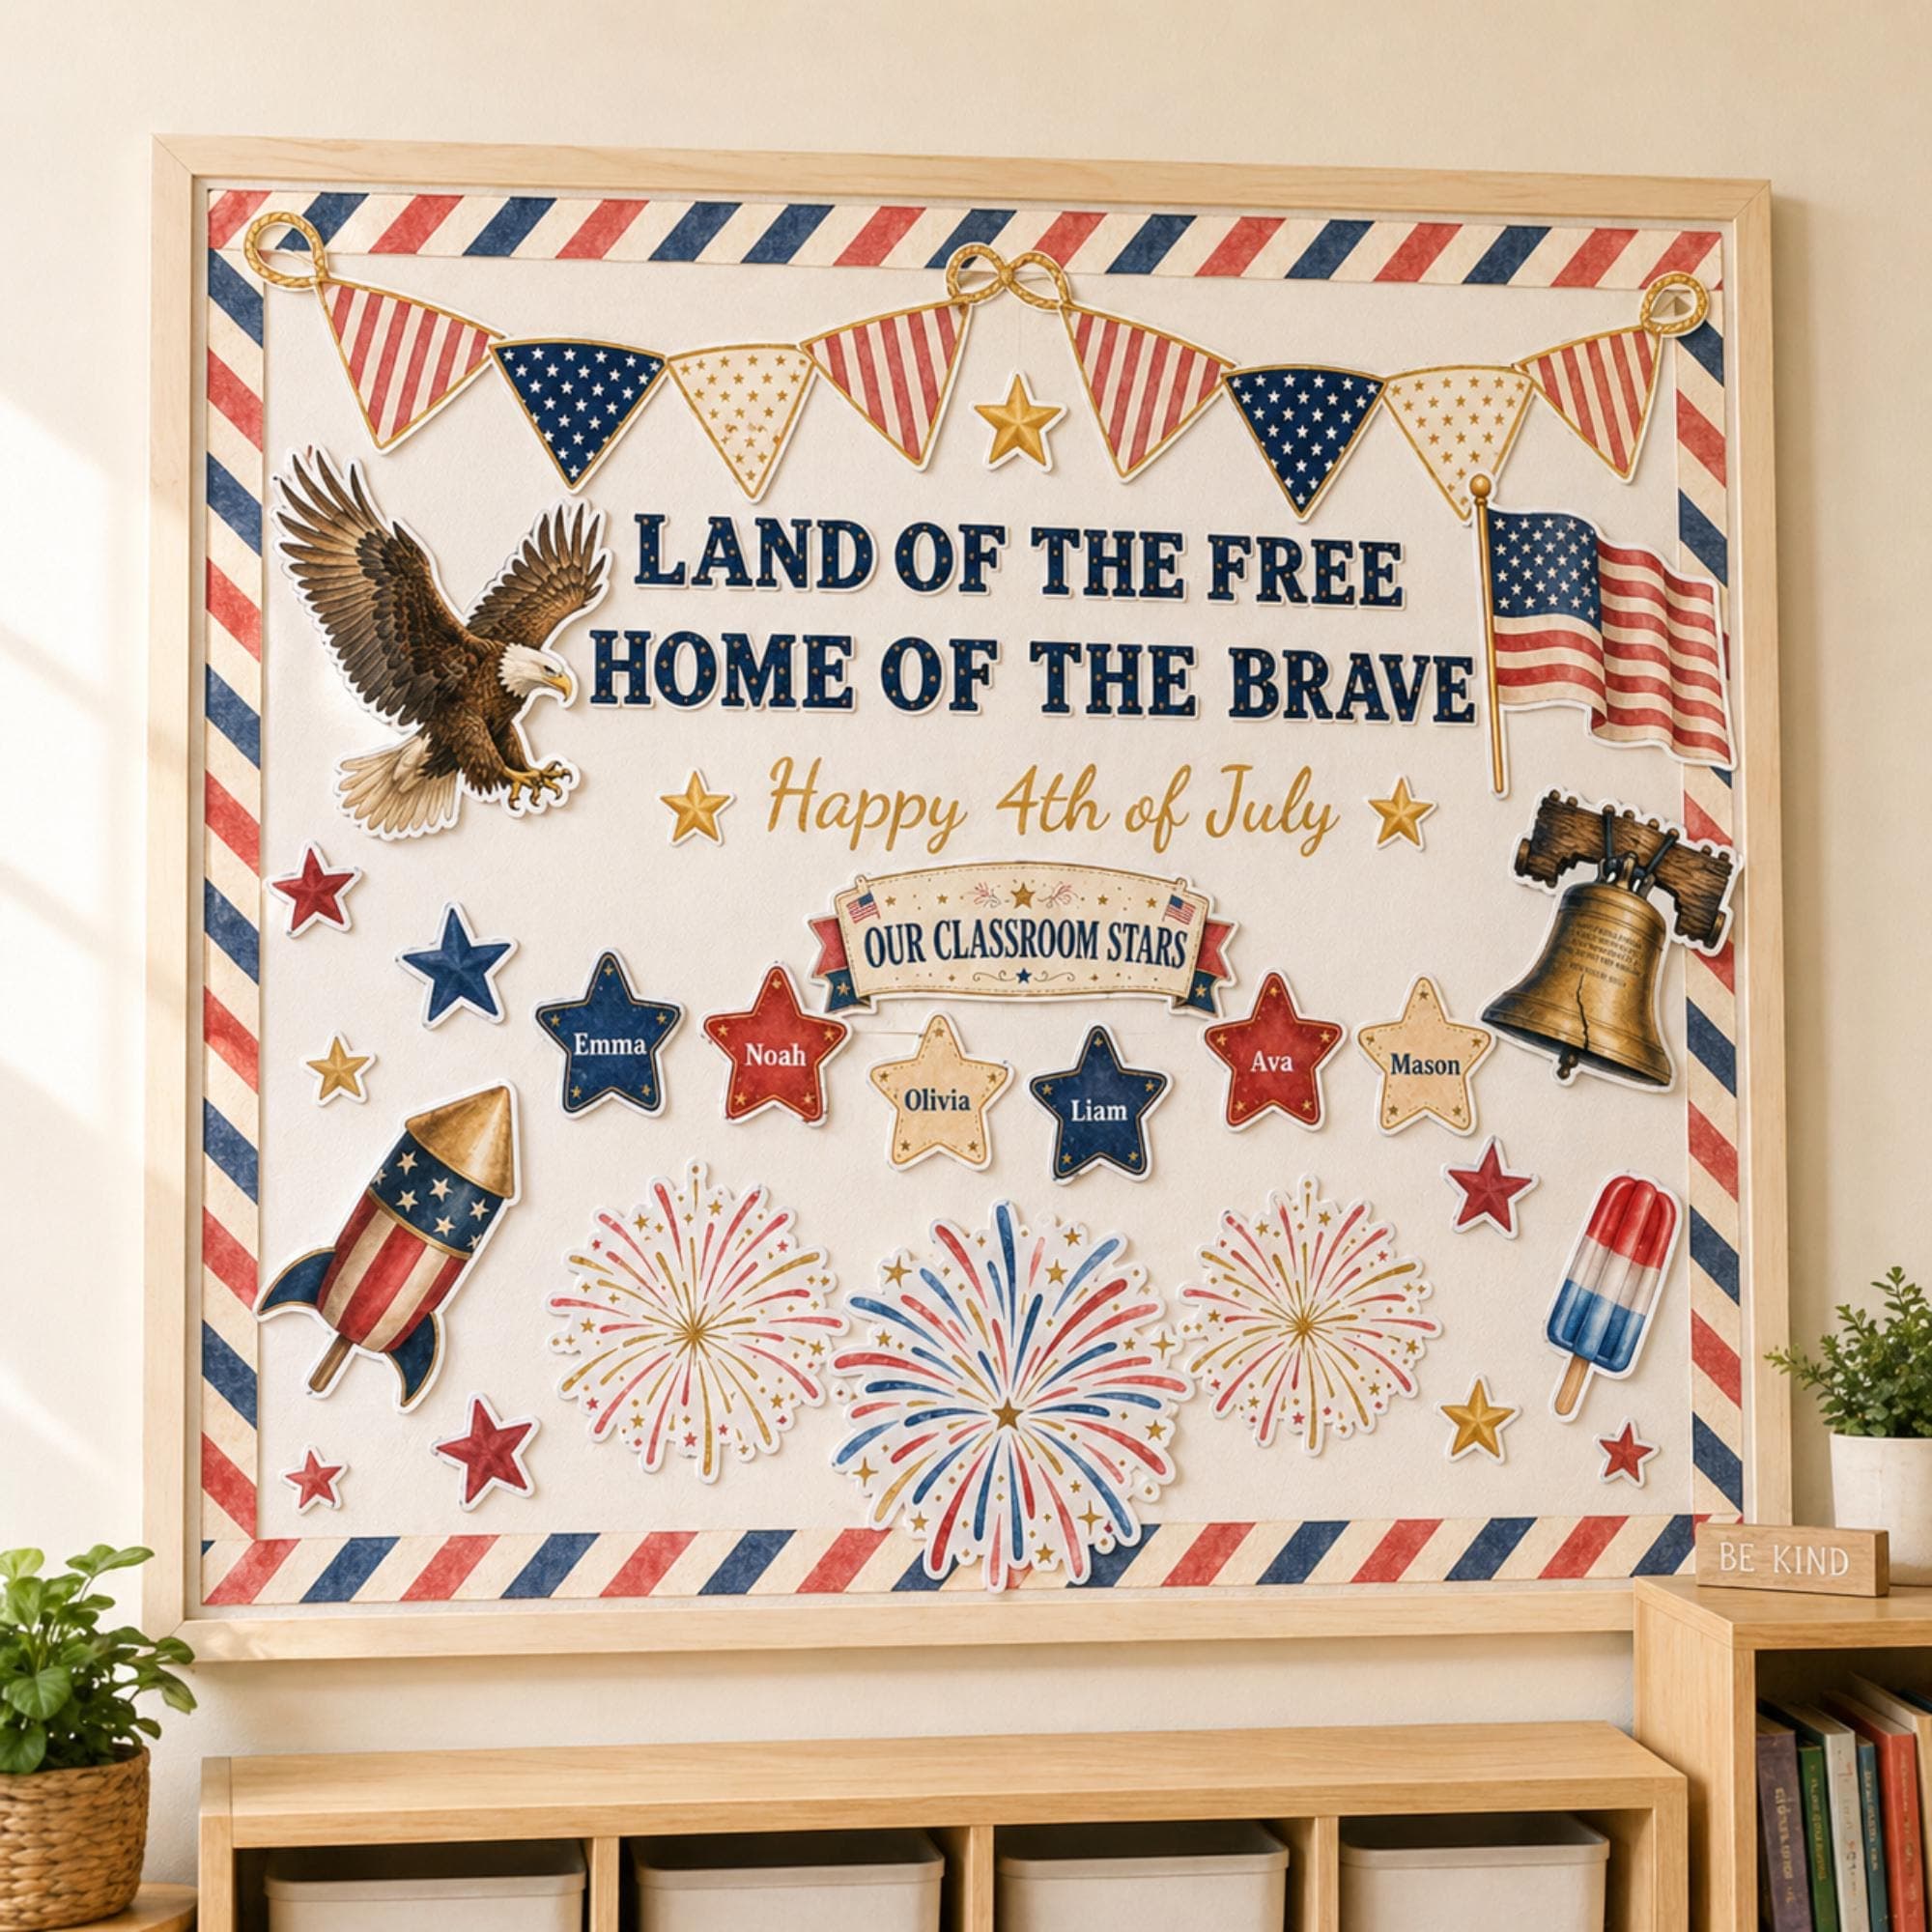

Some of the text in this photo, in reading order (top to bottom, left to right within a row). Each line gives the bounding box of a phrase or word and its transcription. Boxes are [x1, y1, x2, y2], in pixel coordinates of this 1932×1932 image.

[634, 513, 1403, 608] LAND OF THE FREE
[589, 630, 1475, 724] HOME OF THE BRAVE
[767, 755, 1340, 859] Happy 4th of July
[865, 918, 1188, 969] OUR CLASSROOM STARS
[575, 1033, 646, 1055] Emma
[747, 1043, 806, 1066] Noah
[1251, 1050, 1293, 1072] Ava
[1391, 1053, 1461, 1076] Mason
[904, 1088, 971, 1111] Olivia
[1071, 1099, 1127, 1122] Liam
[1719, 1542, 1849, 1577] BE KIND
